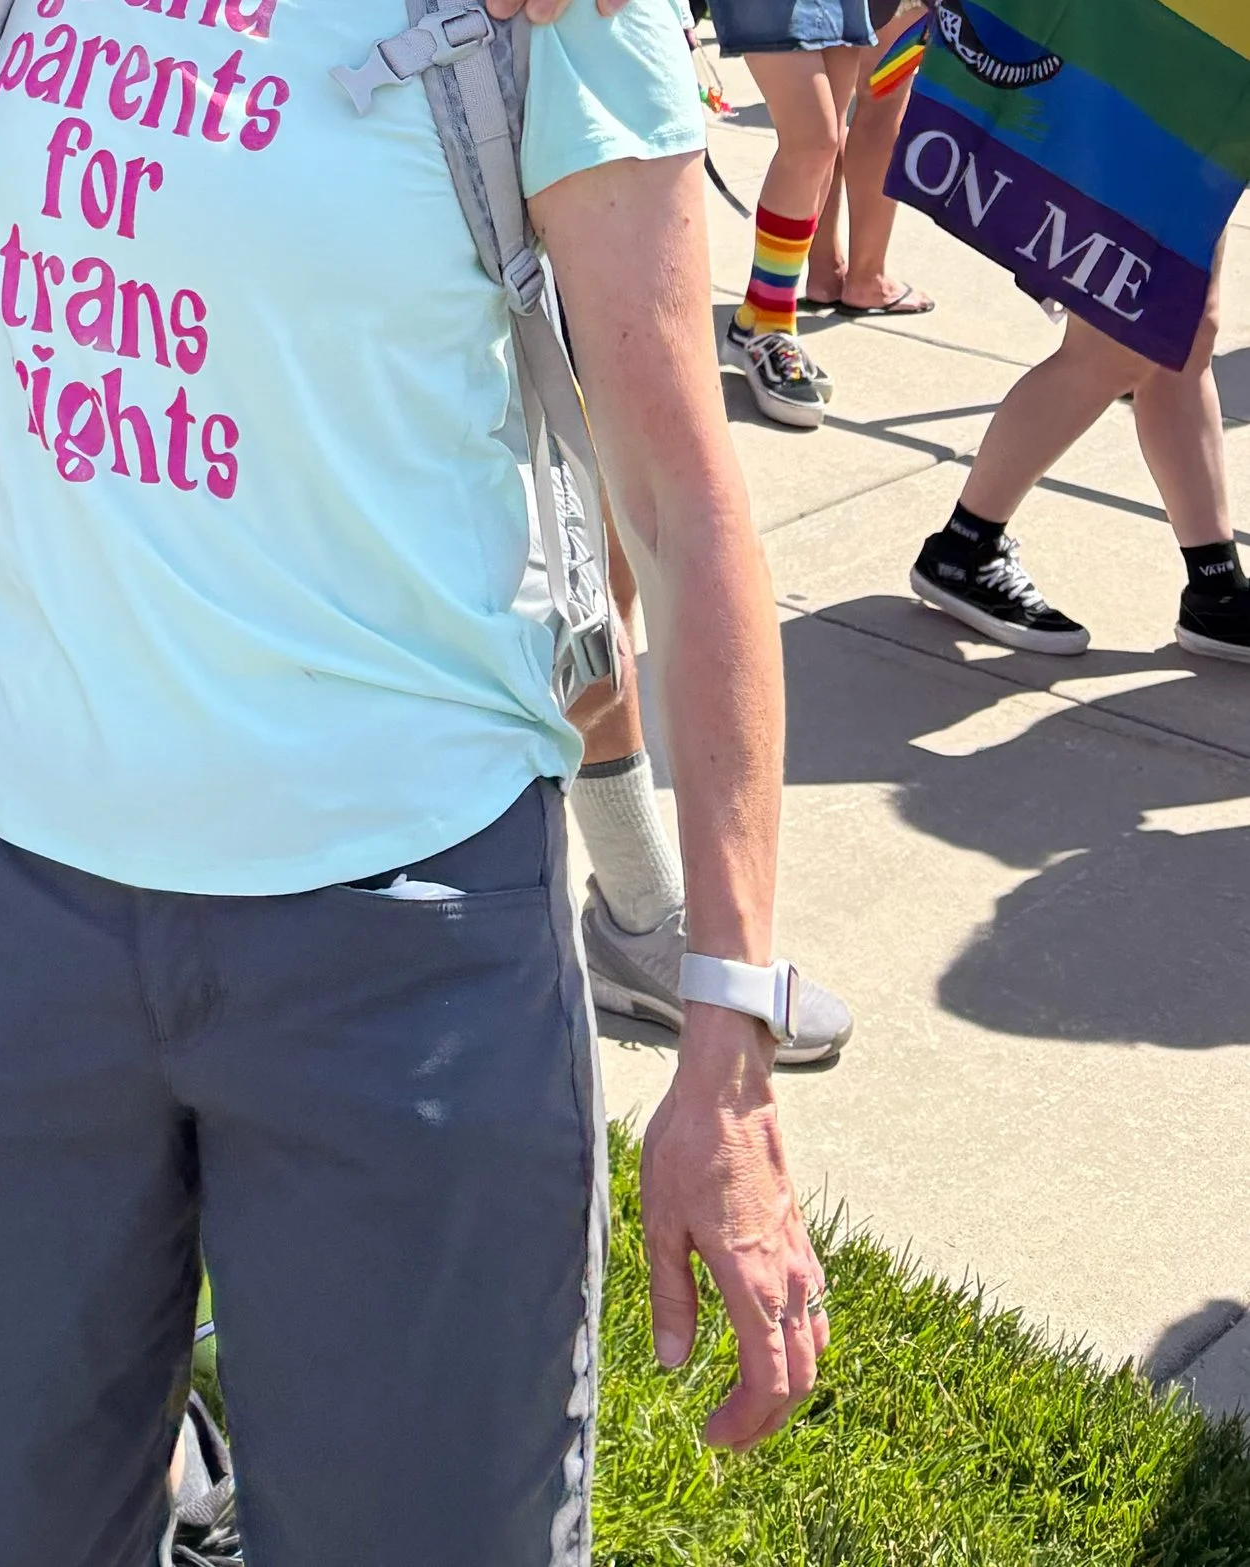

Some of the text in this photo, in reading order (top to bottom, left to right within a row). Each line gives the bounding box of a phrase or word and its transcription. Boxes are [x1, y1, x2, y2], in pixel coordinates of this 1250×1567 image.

[41, 117, 163, 239] for
[904, 130, 1152, 322] ON ME
[0, 223, 208, 375] trans
